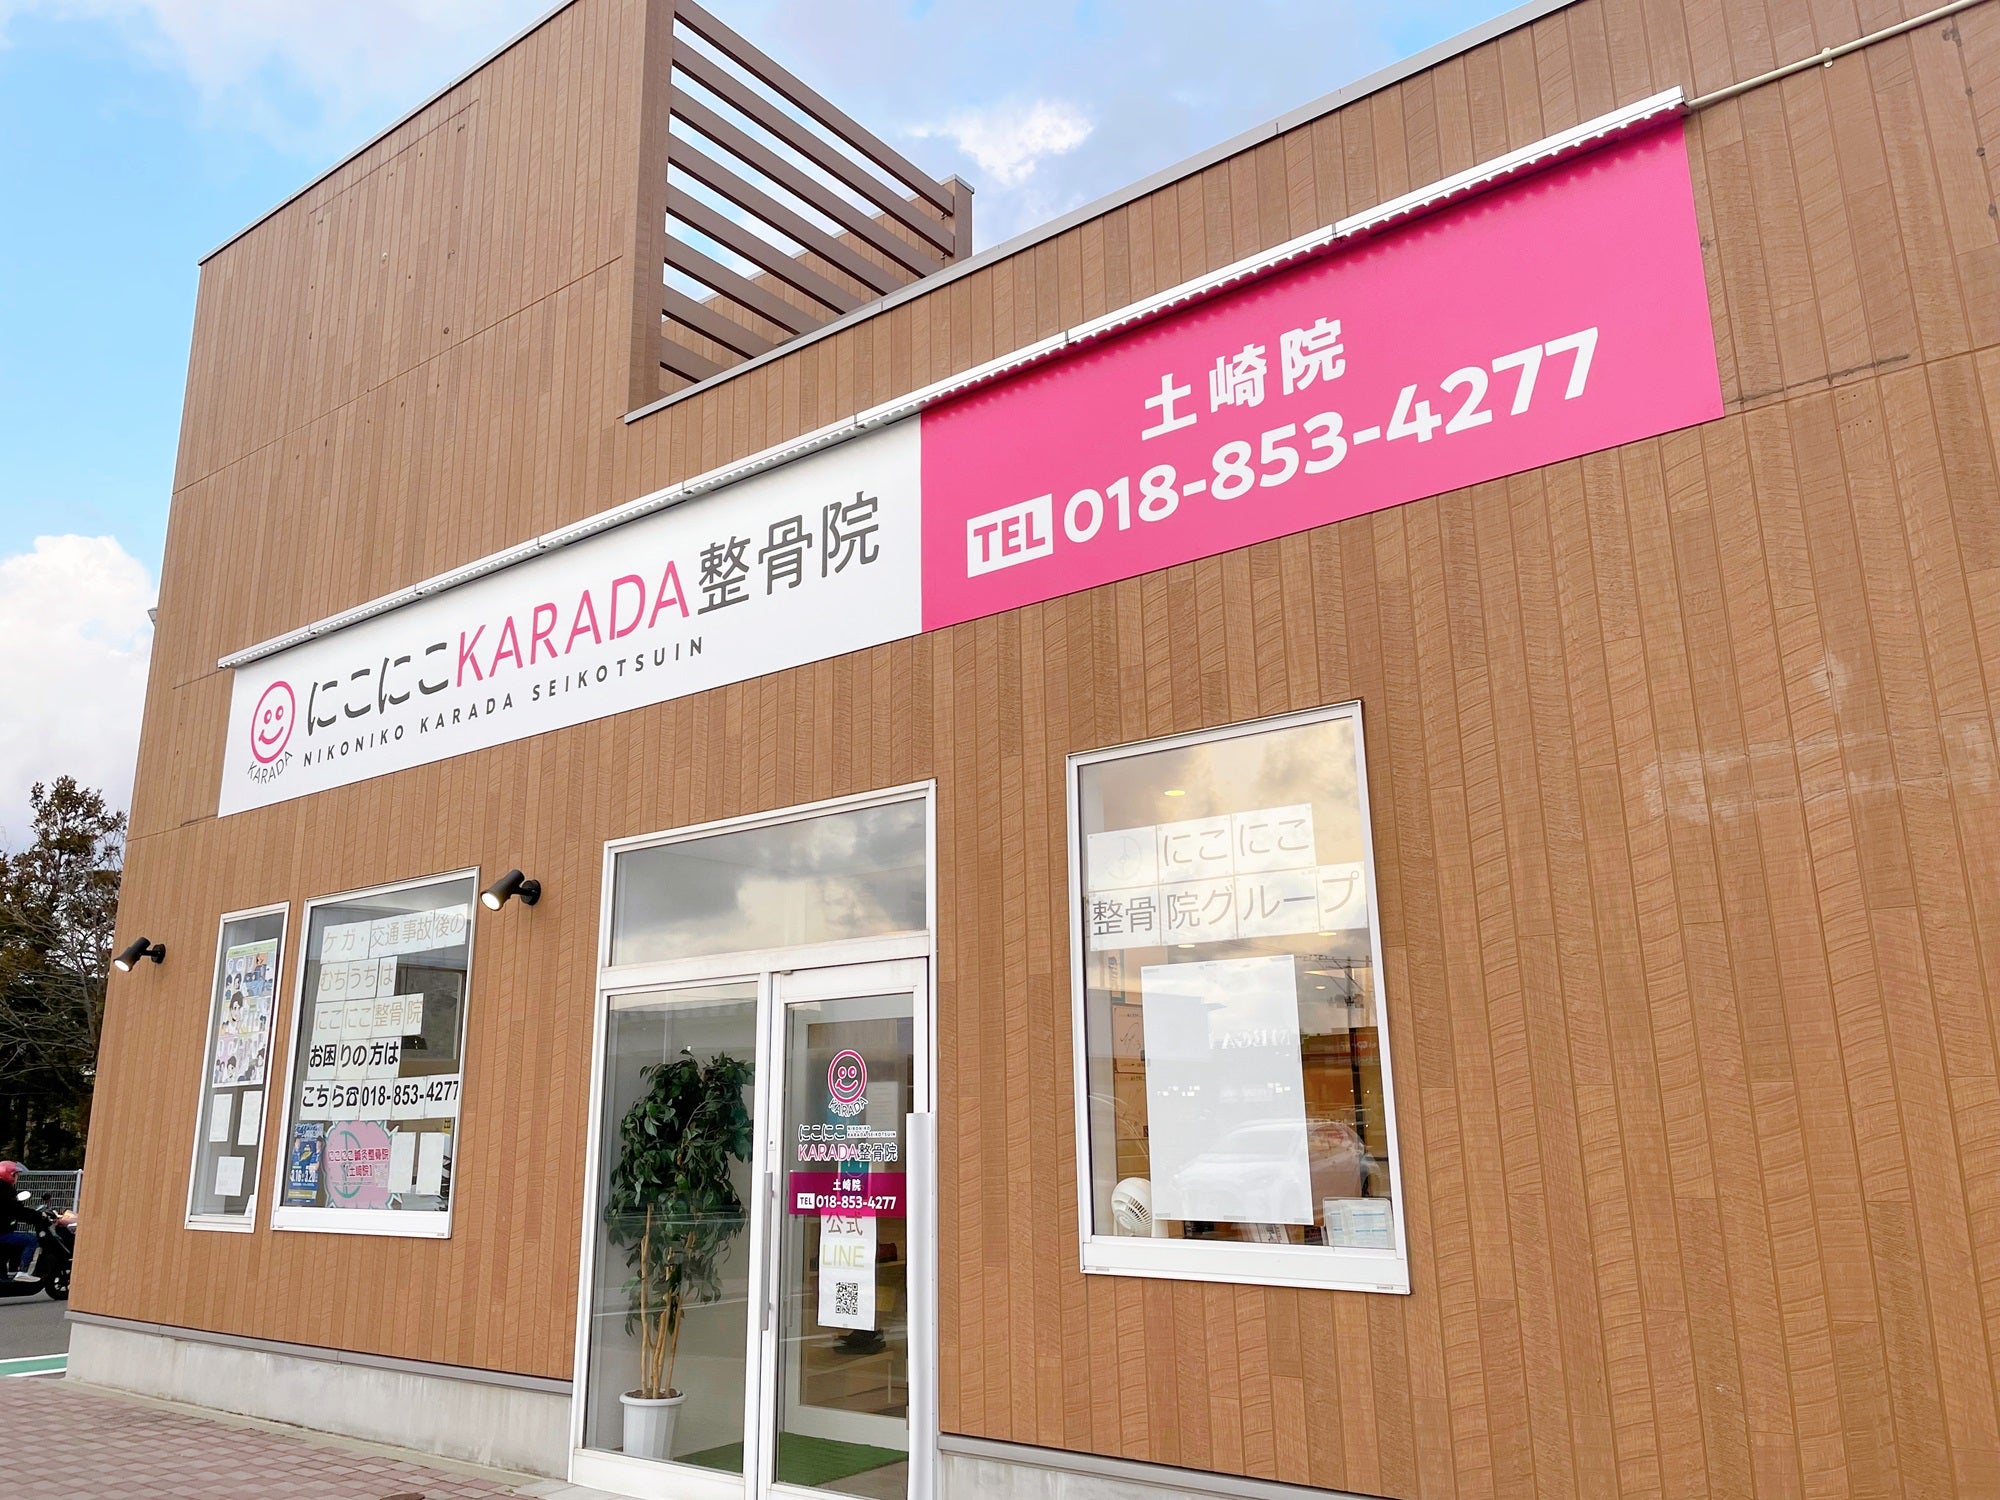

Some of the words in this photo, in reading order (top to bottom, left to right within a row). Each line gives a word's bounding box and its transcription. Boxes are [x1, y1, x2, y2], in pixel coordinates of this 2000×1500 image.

[1141, 317, 1347, 441] 土崎院
[972, 510, 1046, 564] TEL
[1063, 326, 1599, 544] 018-853-4277
[303, 725, 404, 768] NIKONIKO
[420, 692, 513, 734] KARADA
[532, 637, 703, 702] SEIKOTSUIN
[247, 751, 293, 785] KARADA
[1163, 819, 1310, 867] にこにこ
[1092, 870, 1360, 937] 整骨院グループ
[320, 963, 394, 992] むちうちは
[315, 1000, 422, 1031] にこにこ整骨院
[309, 1041, 399, 1068] お困りの方は
[828, 1097, 868, 1117] KARADA
[798, 1123, 845, 1142] にこにこ
[832, 1178, 861, 1191] 土崎院
[816, 1195, 897, 1210] 018-853-4277
[826, 1211, 863, 1236] 公式
[822, 1244, 865, 1268] LINE
